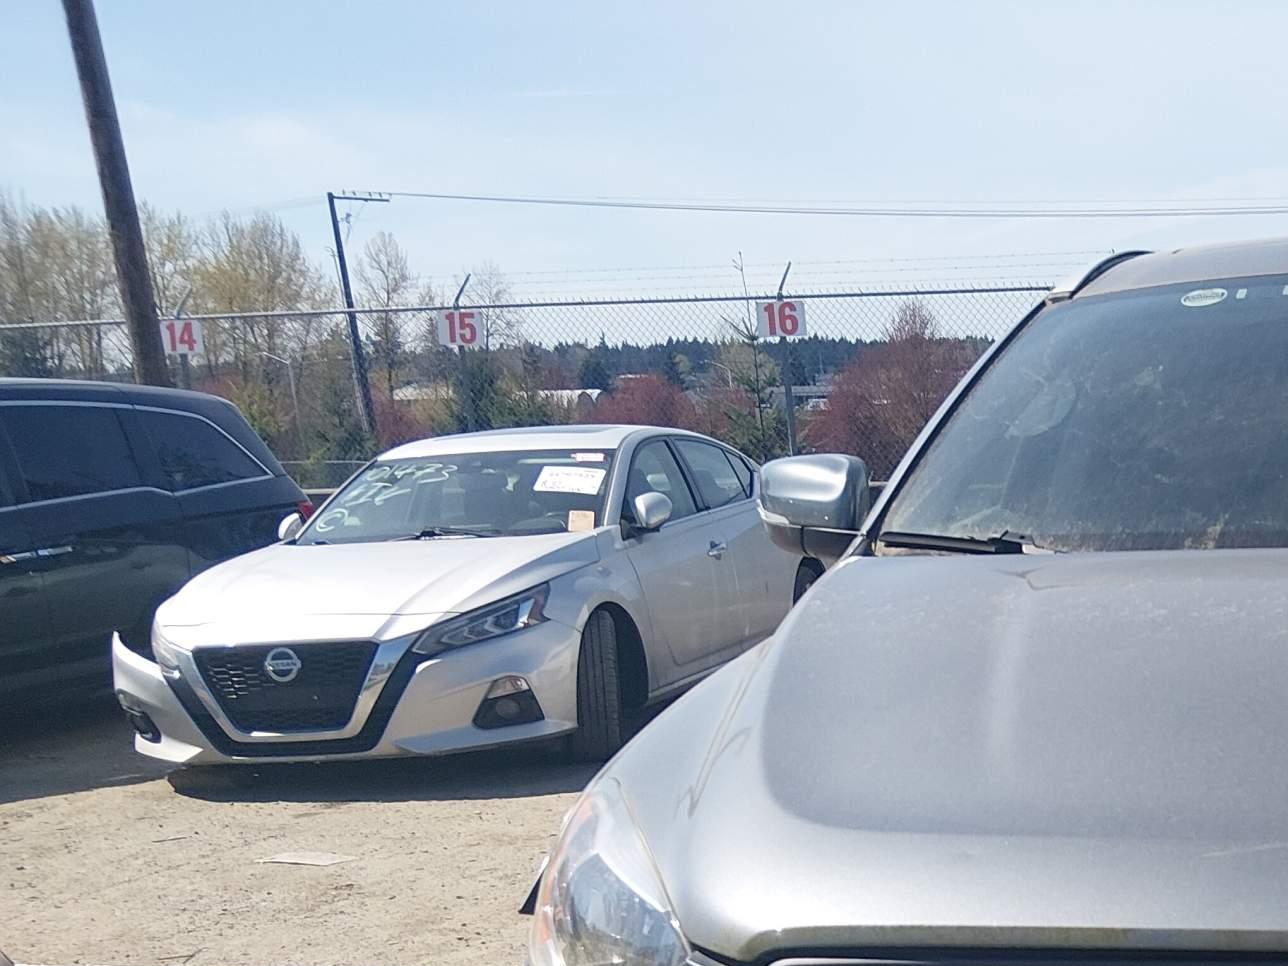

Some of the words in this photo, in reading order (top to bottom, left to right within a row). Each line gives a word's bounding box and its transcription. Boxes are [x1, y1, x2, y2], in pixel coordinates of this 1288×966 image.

[445, 311, 477, 344] 15
[764, 301, 799, 336] 16
[166, 320, 197, 352] 14
